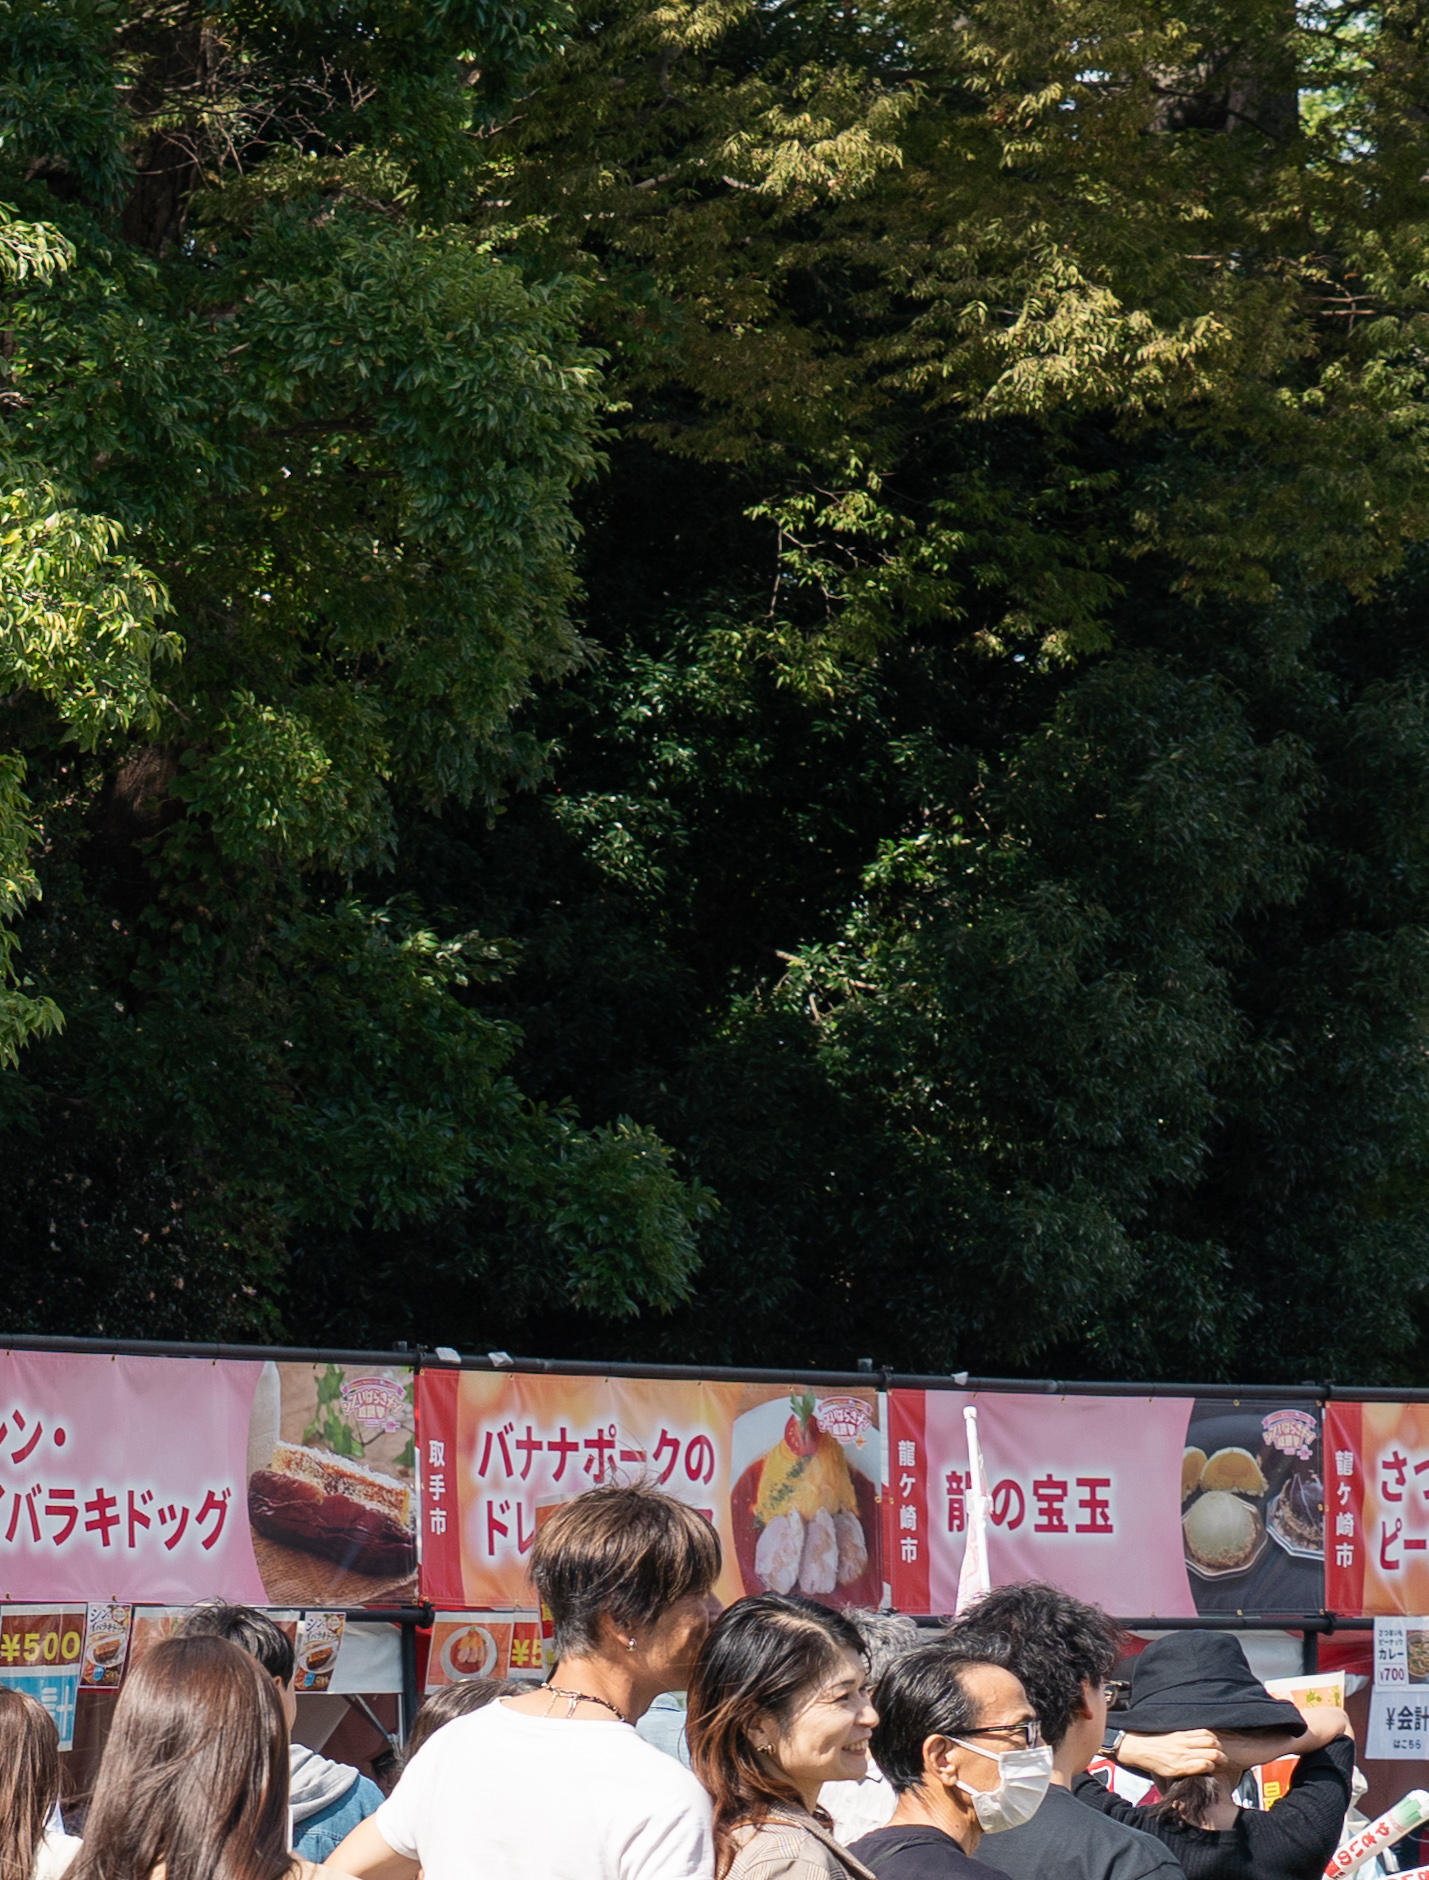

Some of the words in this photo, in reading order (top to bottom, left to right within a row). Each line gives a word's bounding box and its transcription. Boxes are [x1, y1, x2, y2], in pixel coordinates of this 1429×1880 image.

[478, 1424, 715, 1487] バナナポークの
[429, 1440, 446, 1535] 取手市
[1, 1631, 80, 1662] ¥500
[1378, 1648, 1404, 1660] カレー
[1380, 1667, 1405, 1683] ¥700
[1393, 1739, 1421, 1750] はこちら
